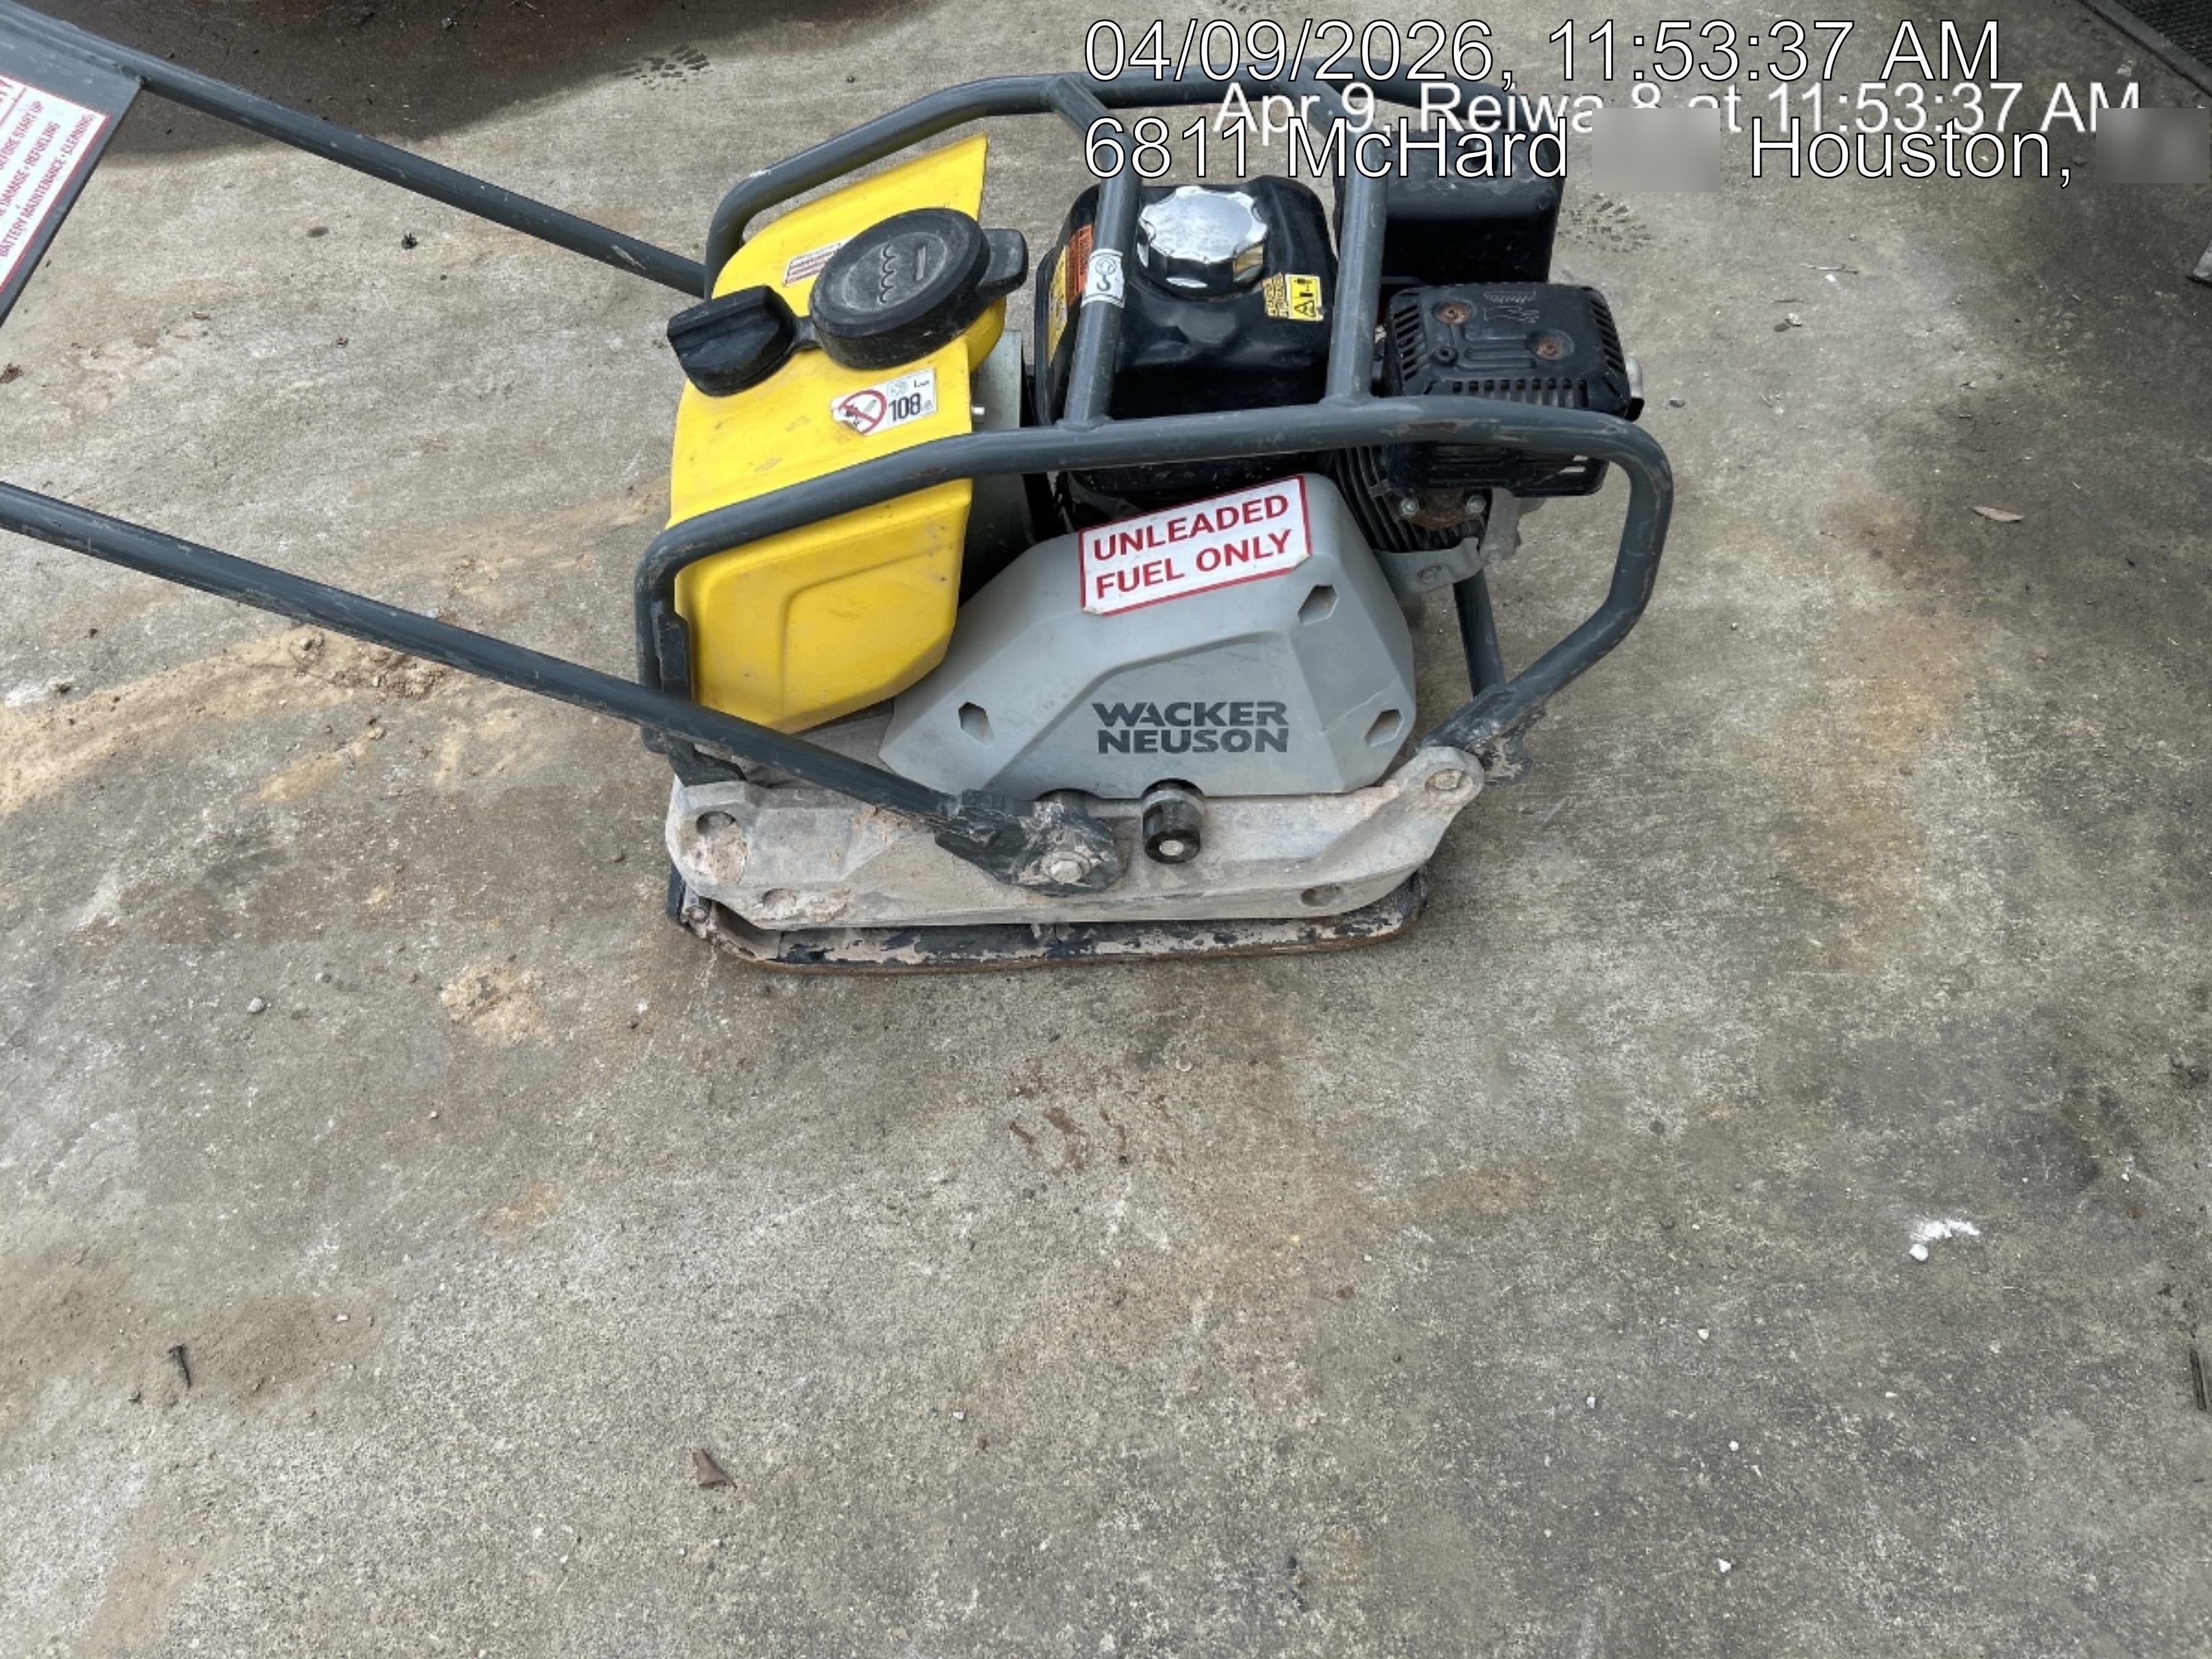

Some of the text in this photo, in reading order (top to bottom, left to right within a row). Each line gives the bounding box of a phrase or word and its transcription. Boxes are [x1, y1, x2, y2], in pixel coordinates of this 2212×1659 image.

[889, 392, 920, 422] 108
[1094, 495, 1288, 560] UNLEADED
[1096, 529, 1293, 598] FUEL ONLY
[1091, 701, 1288, 727] WACKER
[1097, 728, 1288, 754] NEUSON
